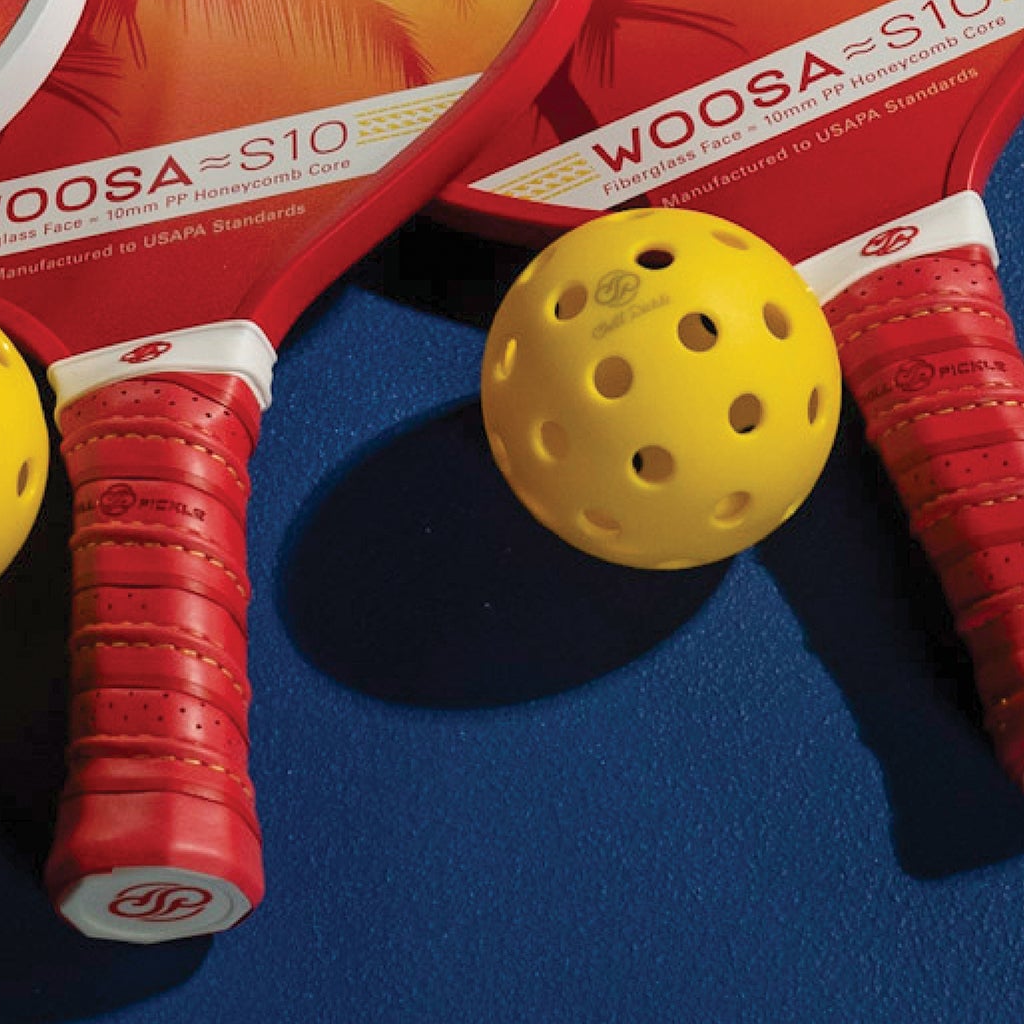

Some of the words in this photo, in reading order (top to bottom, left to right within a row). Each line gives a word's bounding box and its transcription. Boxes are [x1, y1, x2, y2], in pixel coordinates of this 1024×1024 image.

[591, 50, 845, 173] WOOSA
[602, 150, 696, 196] Fiberglass
[700, 131, 742, 154] Face
[763, 97, 817, 126] 10mm
[822, 83, 844, 101] PP
[850, 36, 958, 89] Honeycomb
[963, 16, 1006, 39] Core
[661, 147, 789, 208] Manufactured
[792, 138, 811, 153] to
[815, 108, 881, 144] USAPA
[884, 66, 979, 113] Standards
[43, 218, 82, 235] Face
[106, 201, 158, 221] 10mm
[165, 193, 188, 208] PP
[194, 168, 302, 201] Honeycomb
[308, 159, 350, 176] Core
[120, 241, 136, 254] to
[143, 225, 207, 249] USAPA
[212, 204, 306, 233] Standards
